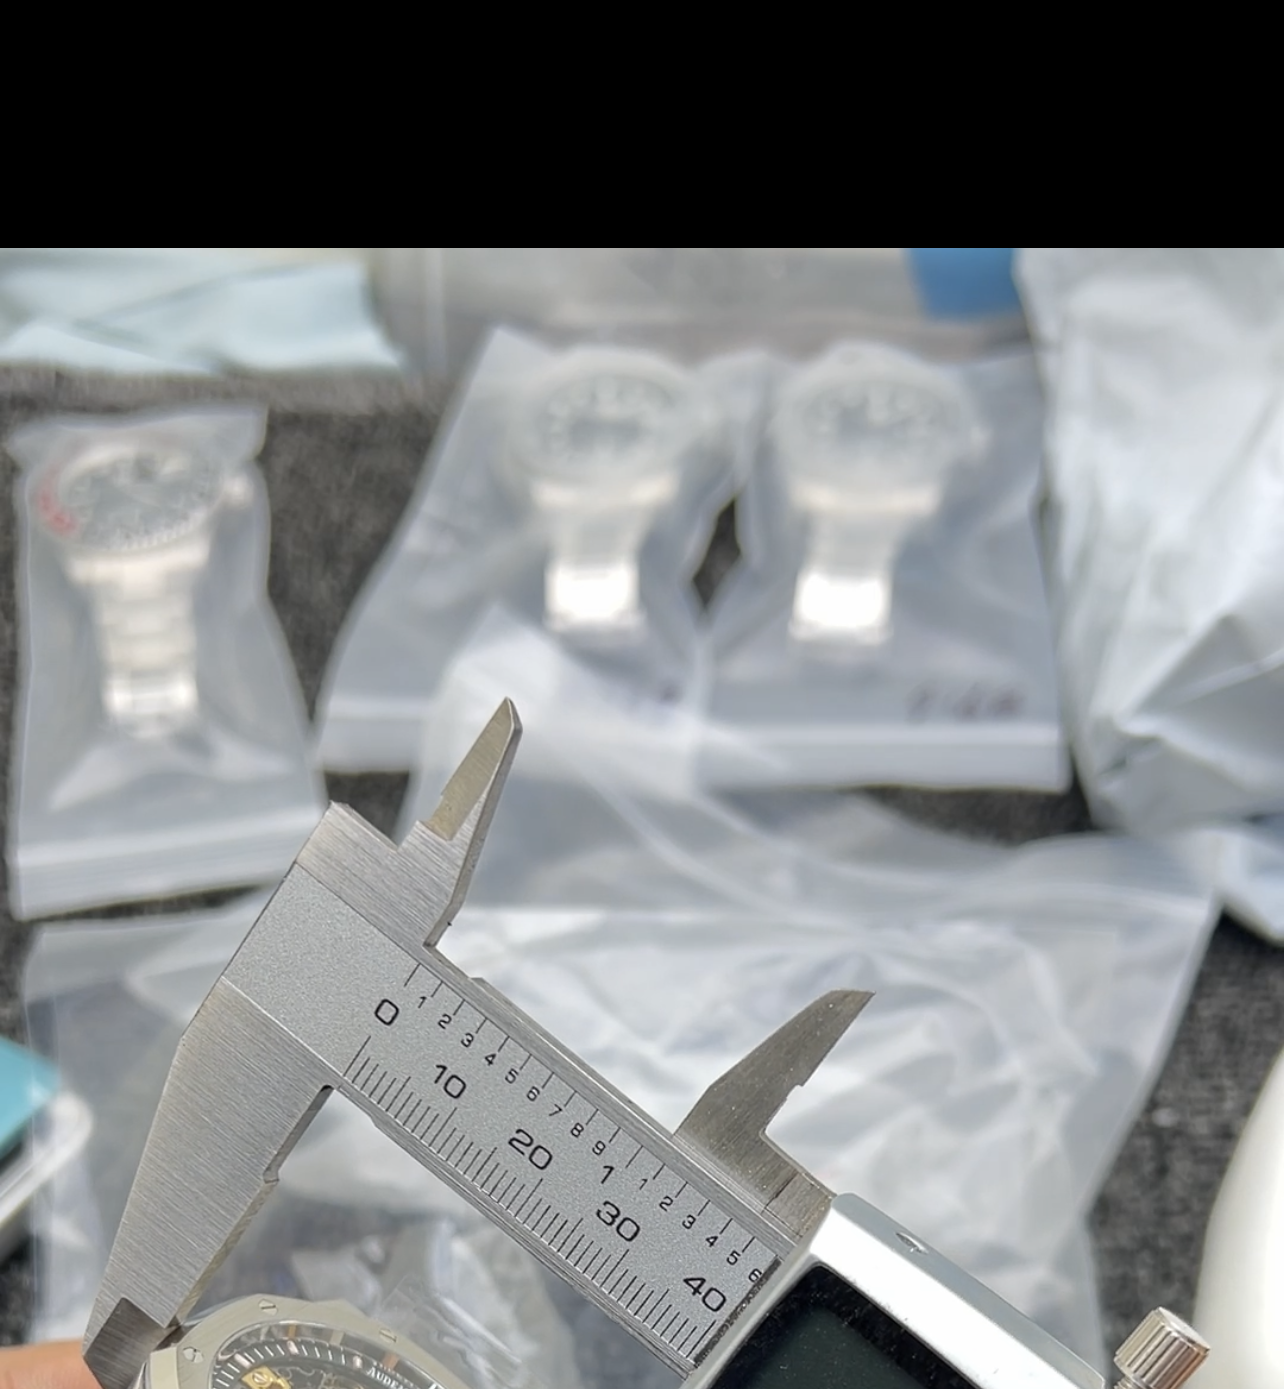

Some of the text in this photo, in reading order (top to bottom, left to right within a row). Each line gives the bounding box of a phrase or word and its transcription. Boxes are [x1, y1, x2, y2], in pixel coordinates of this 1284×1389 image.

[374, 998, 727, 1313] 0 10 20 30 40
[417, 995, 763, 1283] 1 2 3 4 5 6 7 8 9 1 1 2 3 4 5 6
